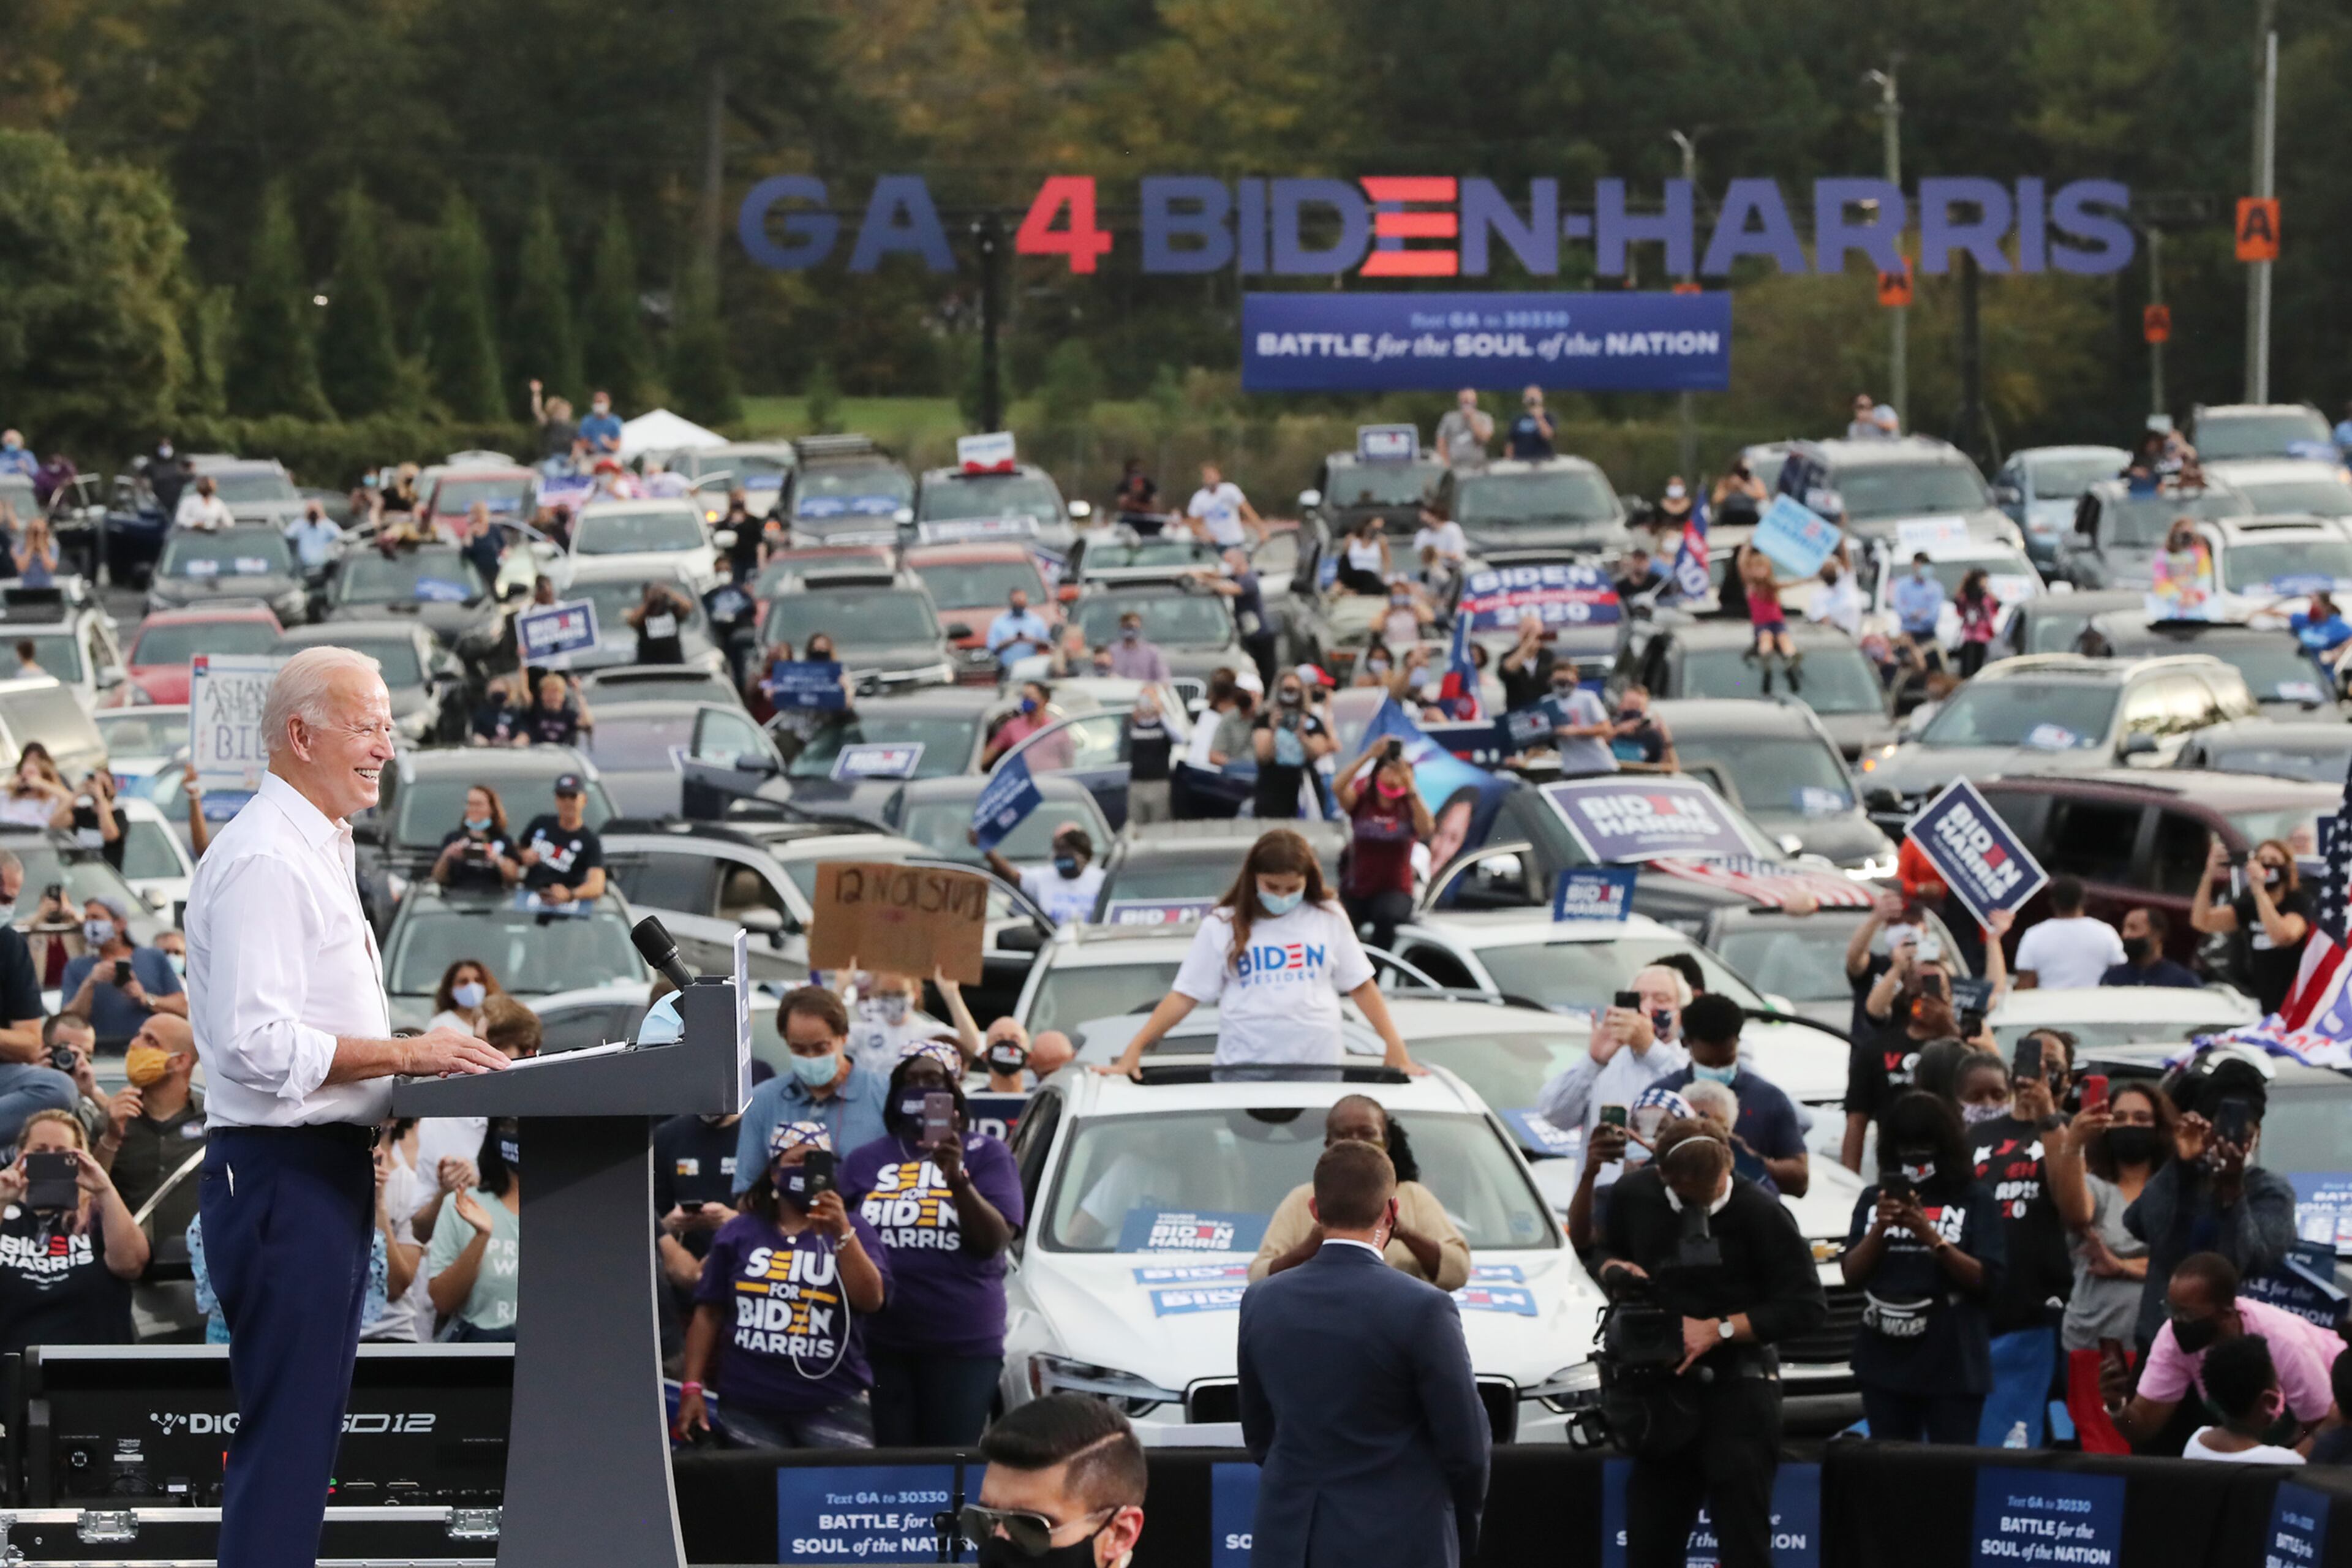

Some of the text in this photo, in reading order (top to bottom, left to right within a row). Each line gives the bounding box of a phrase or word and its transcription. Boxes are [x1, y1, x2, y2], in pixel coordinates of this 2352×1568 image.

[737, 174, 957, 273] GA
[1014, 175, 1113, 274] 4
[2242, 206, 2272, 243] A
[1256, 331, 1719, 363] BATTLE for the SOUL of the NATION
[1471, 565, 1597, 593] BIDEN
[1578, 794, 1709, 820] BIDEN
[1593, 815, 1721, 838] HARRIS
[1947, 801, 2024, 889] BIDEN
[1934, 815, 2008, 900] HARRIS
[1237, 943, 1324, 978] BIDEN
[860, 1198, 960, 1227] BIDEN
[880, 1227, 961, 1251] ARRIS
[1148, 1237, 1232, 1250] HARRIS
[1152, 1225, 1235, 1240] BIDEN
[0, 1234, 92, 1257] BIDEN
[0, 1249, 94, 1274] HARRIS
[744, 1246, 835, 1287] SEIU
[1142, 1268, 1248, 1280] BIDE
[769, 1281, 801, 1300] FOR
[736, 1295, 834, 1336] BIDEN
[734, 1327, 835, 1359] HARRIS
[189, 1412, 241, 1434] DiG
[825, 1491, 949, 1505] Text GA to 30330
[2027, 1496, 2044, 1509] GA
[818, 1512, 927, 1532] BATTLE for
[2000, 1516, 2095, 1540] BATTLE for the
[792, 1538, 850, 1554] SOUL
[852, 1537, 873, 1557] of
[872, 1537, 898, 1553] the
[1226, 1534, 1253, 1550] SO
[1981, 1538, 2111, 1566] SOUL of the NATION
